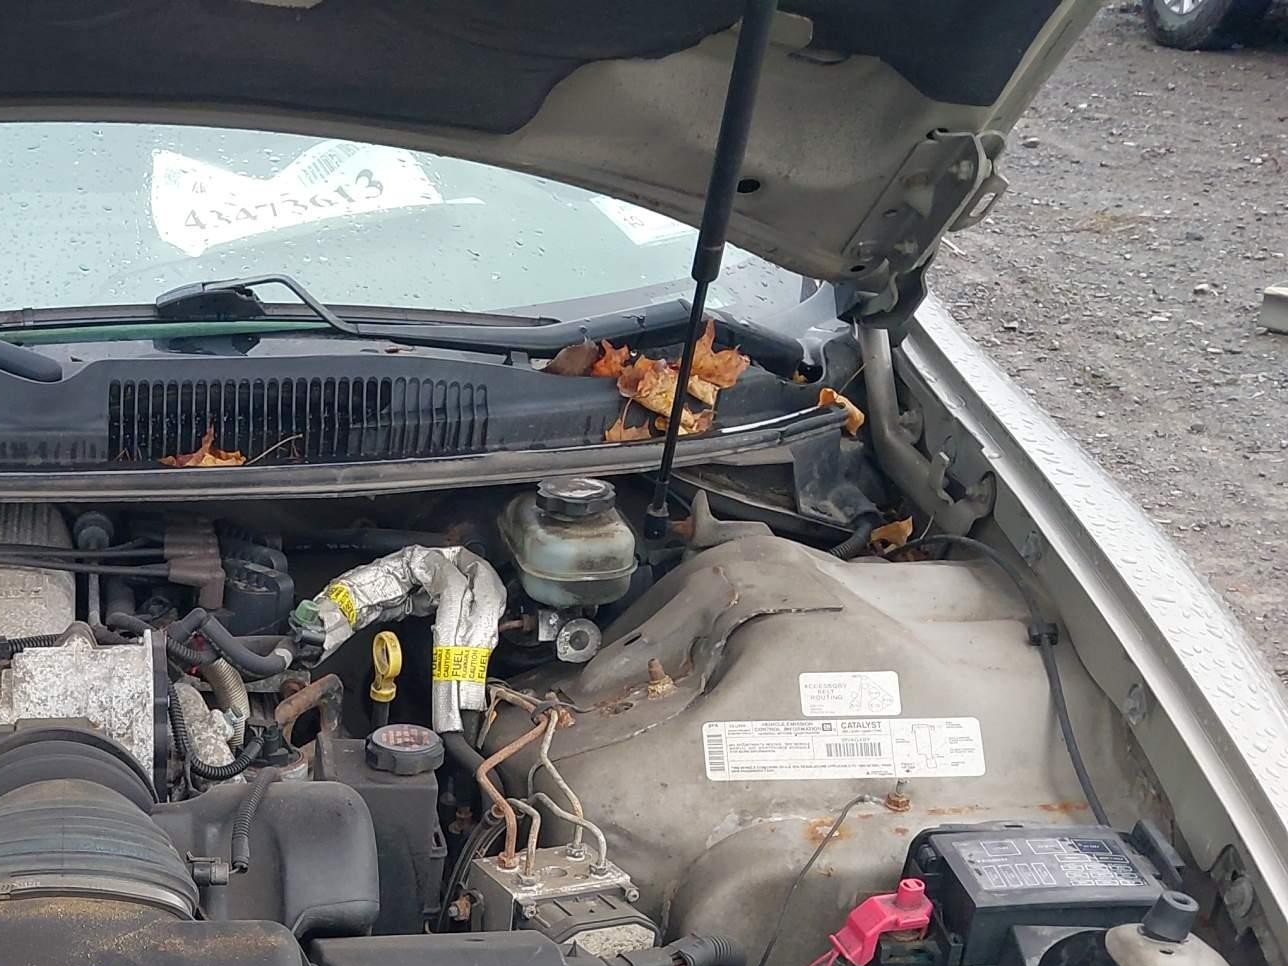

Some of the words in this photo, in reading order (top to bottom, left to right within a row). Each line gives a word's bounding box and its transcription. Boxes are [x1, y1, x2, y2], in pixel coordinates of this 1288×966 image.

[443, 649, 451, 678] CAUTION
[452, 651, 463, 677] FUEL
[469, 650, 477, 679] CAUTION
[478, 654, 488, 679] FUEL
[841, 721, 881, 729] CATALYST
